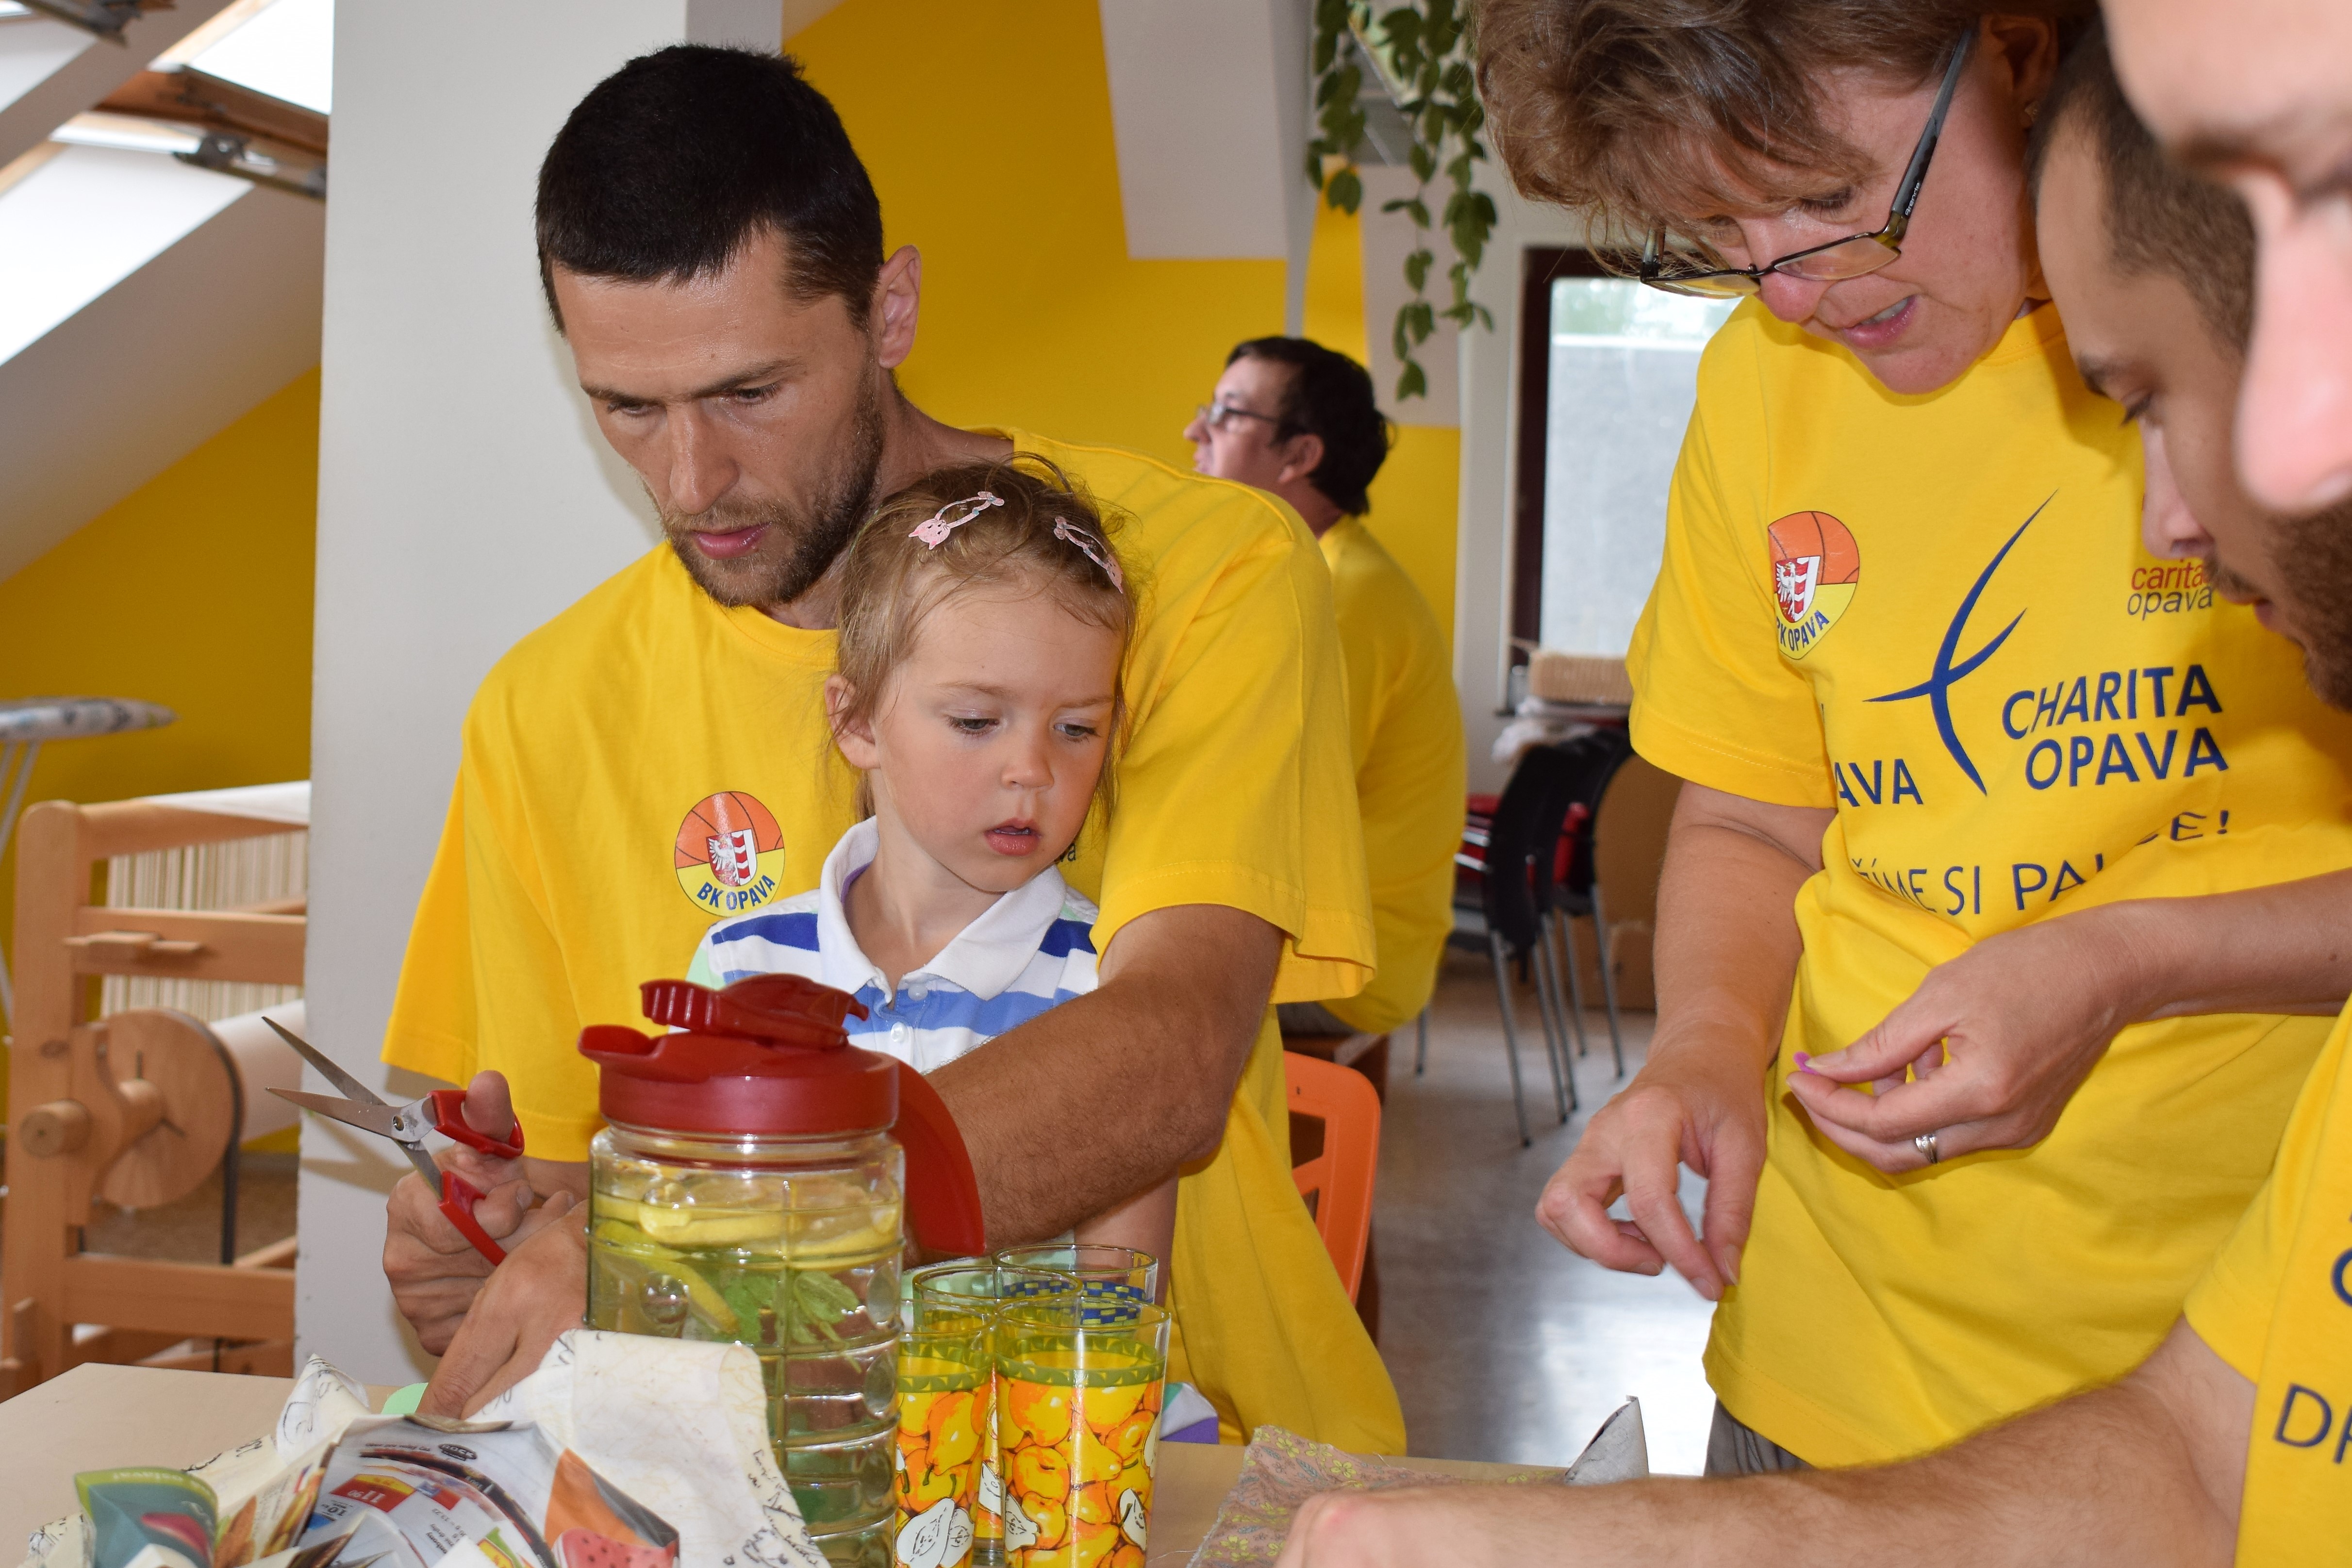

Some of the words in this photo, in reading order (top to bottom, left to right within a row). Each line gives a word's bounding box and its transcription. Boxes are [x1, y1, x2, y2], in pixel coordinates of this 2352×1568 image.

[2131, 559, 2204, 591] carita
[2127, 585, 2212, 621] opava
[1788, 610, 1830, 651] OPAVA
[2002, 664, 2223, 740] CHARITA
[2025, 727, 2229, 790] OPAVA
[1834, 758, 1924, 807] AVA
[696, 881, 724, 908] BK
[726, 874, 776, 911] OPAVA
[1943, 865, 1980, 916] SI
